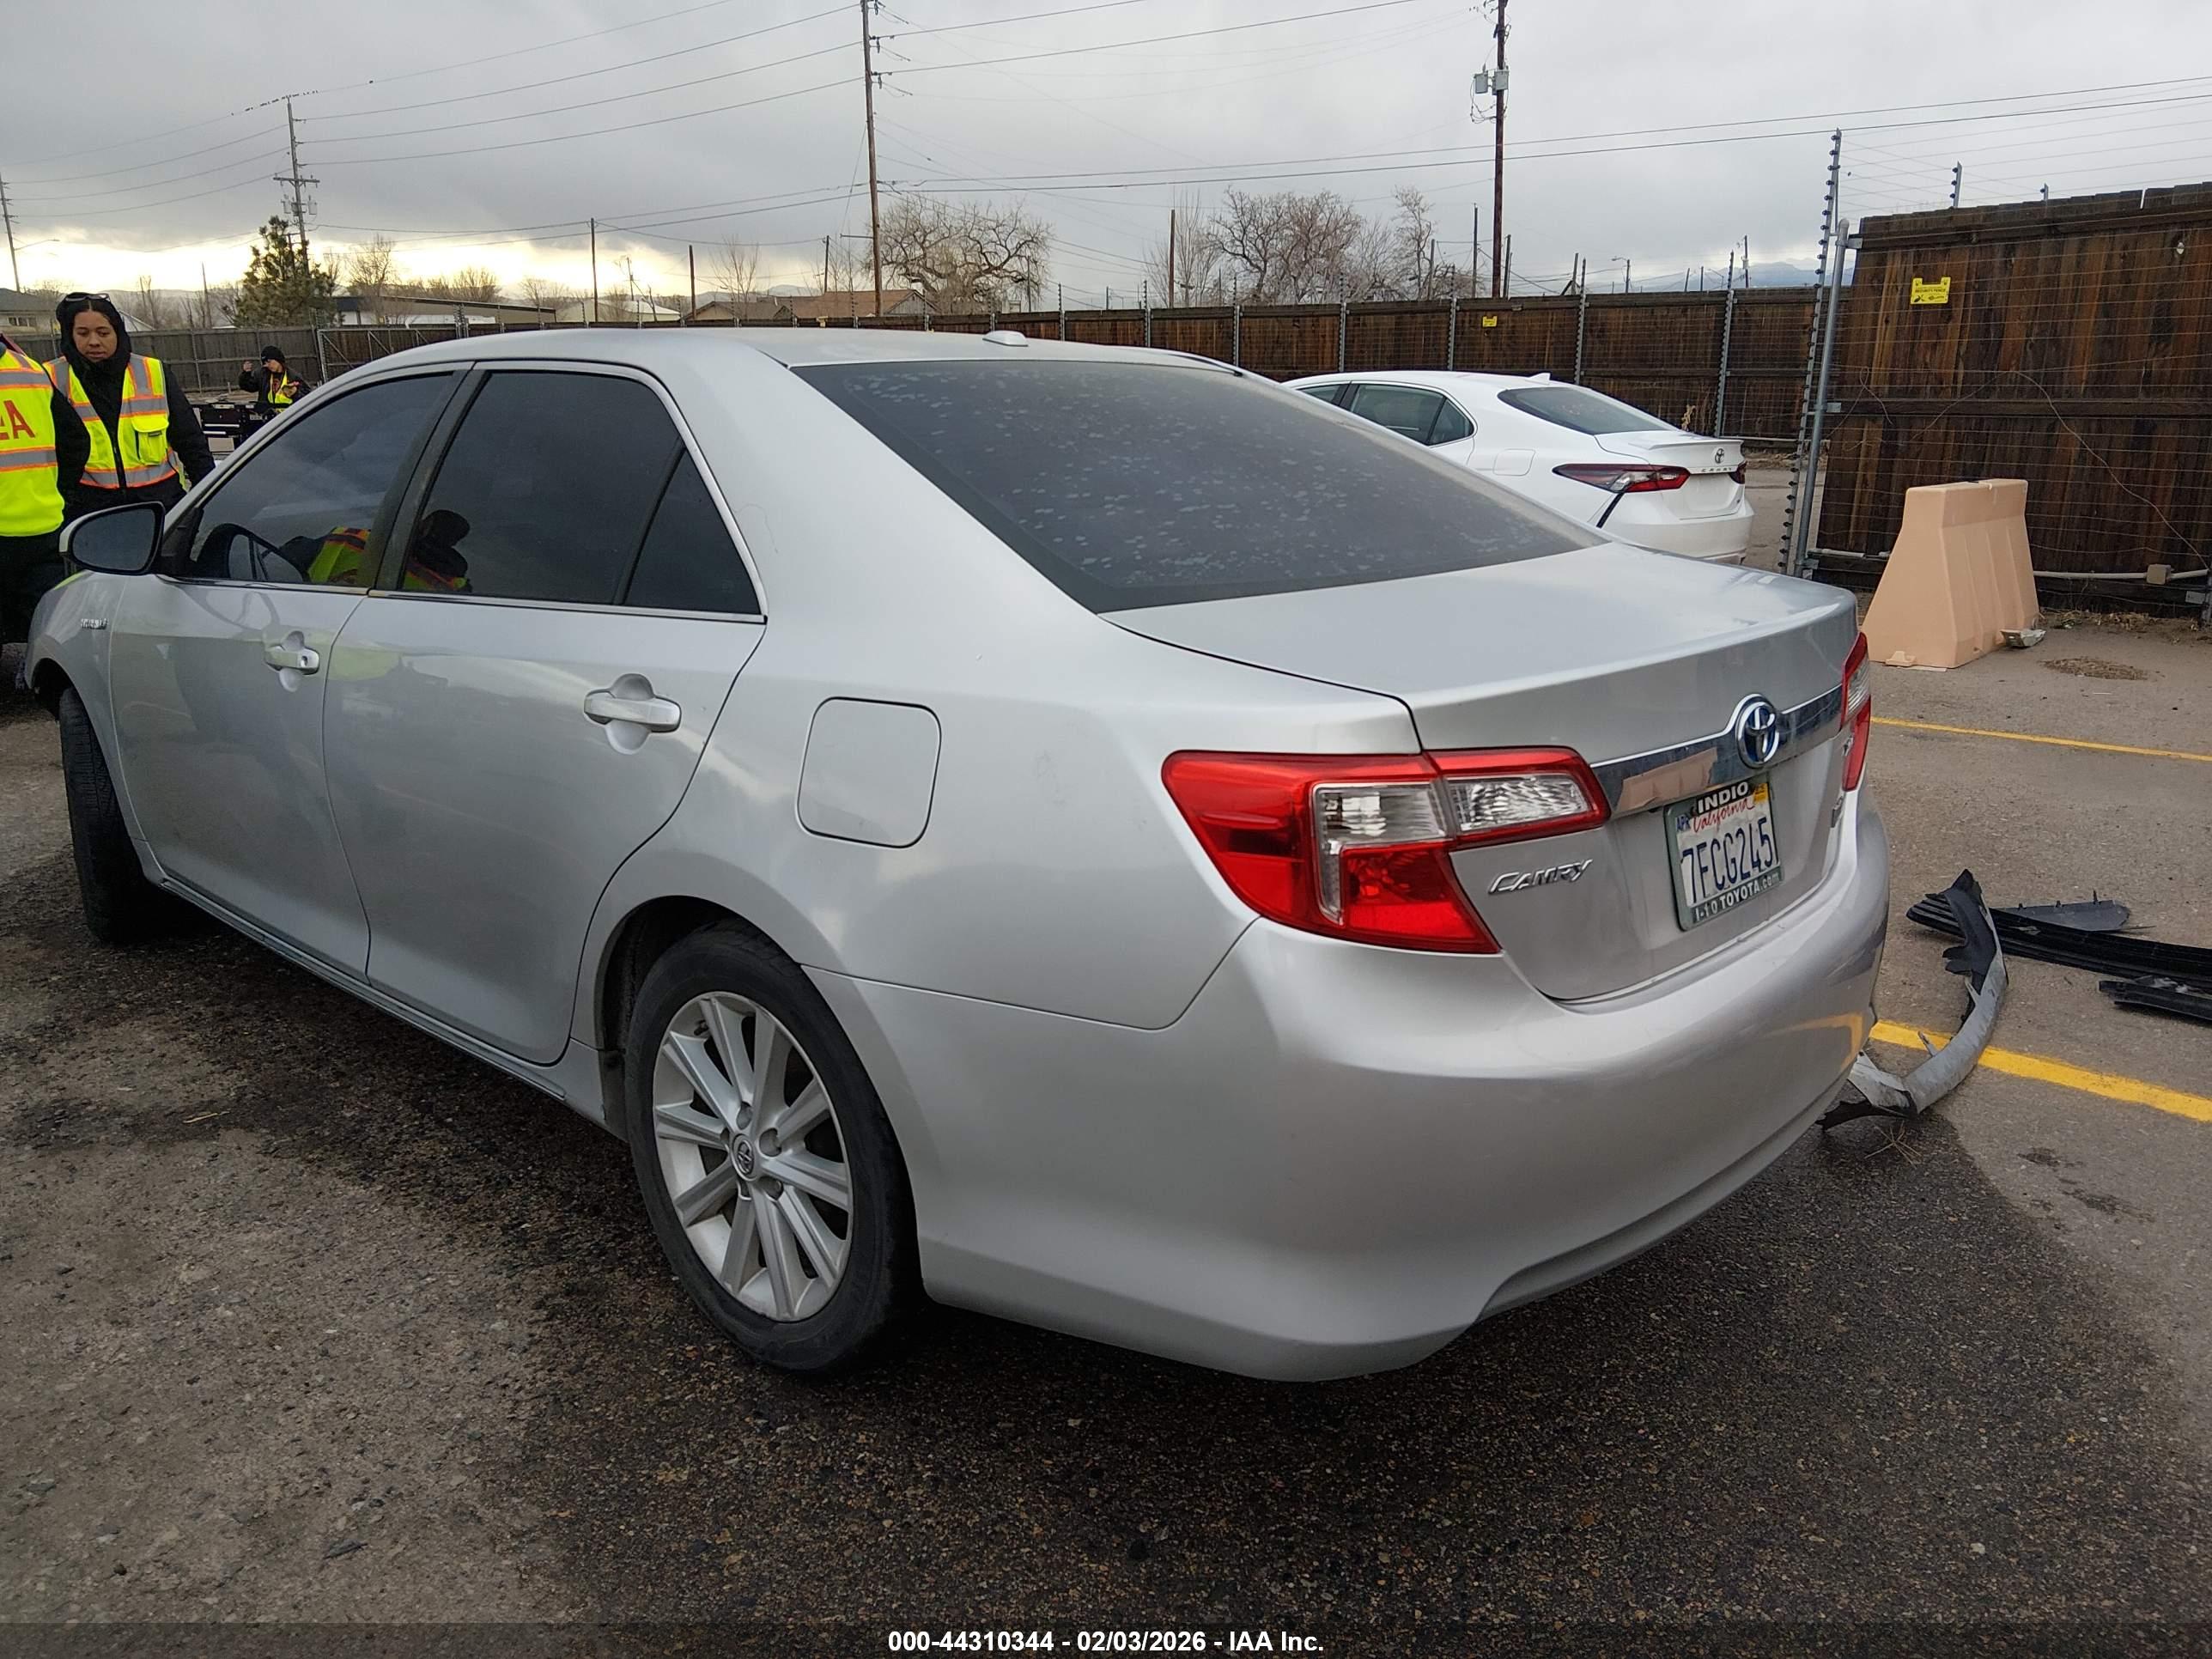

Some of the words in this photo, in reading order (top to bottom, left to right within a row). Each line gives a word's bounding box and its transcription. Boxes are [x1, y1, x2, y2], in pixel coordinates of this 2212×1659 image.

[1698, 781, 1749, 814] INDIO
[1488, 859, 1593, 895] CAMRY
[1680, 817, 1773, 903] 7FCG245
[1720, 872, 1780, 910] TOYOTA.com
